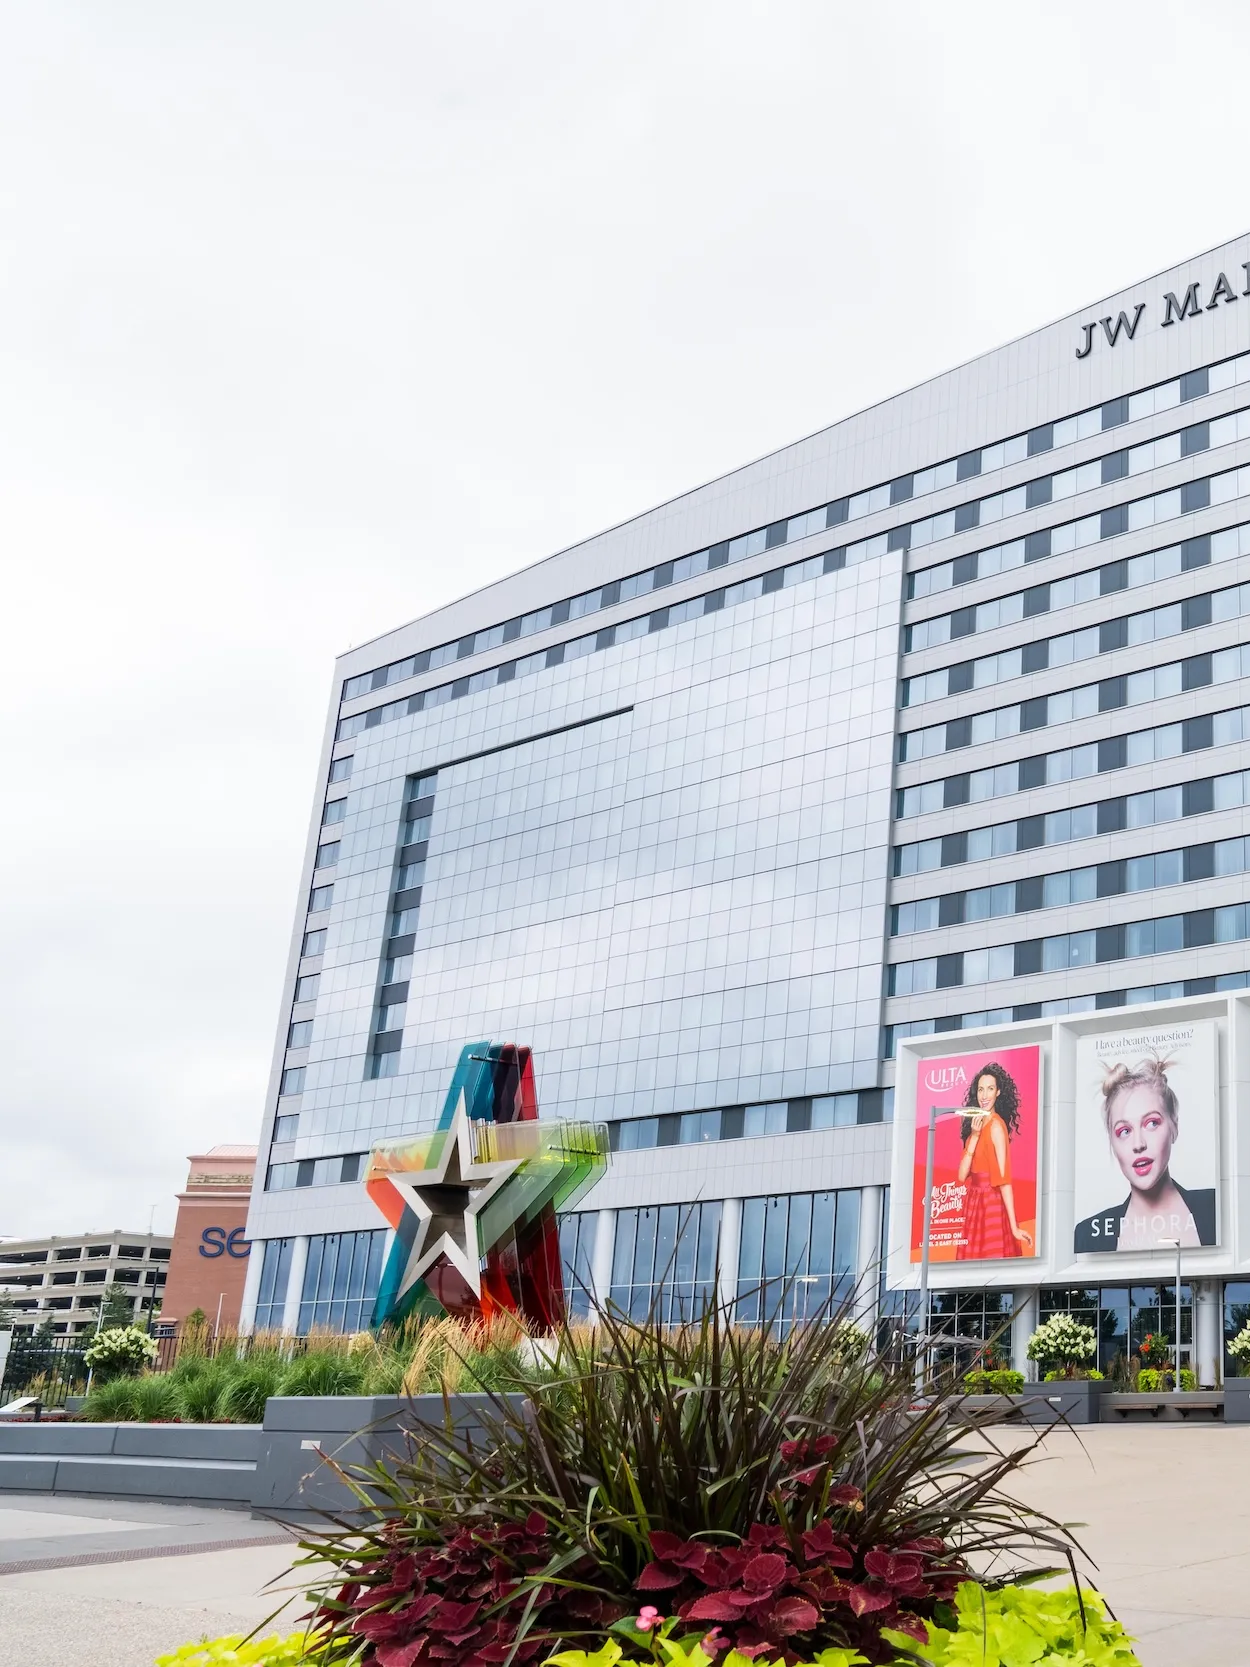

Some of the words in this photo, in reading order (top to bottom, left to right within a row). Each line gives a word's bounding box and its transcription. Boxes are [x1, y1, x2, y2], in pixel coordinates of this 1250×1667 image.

[1075, 302, 1147, 359] JW
[1095, 1040, 1116, 1050] Have
[1122, 1036, 1151, 1047] beauty
[1152, 1029, 1194, 1046] question?
[930, 1066, 967, 1085] ULTA
[940, 1181, 968, 1203] Things
[930, 1196, 963, 1219] Beauty
[1090, 1213, 1198, 1237] SEPHORA
